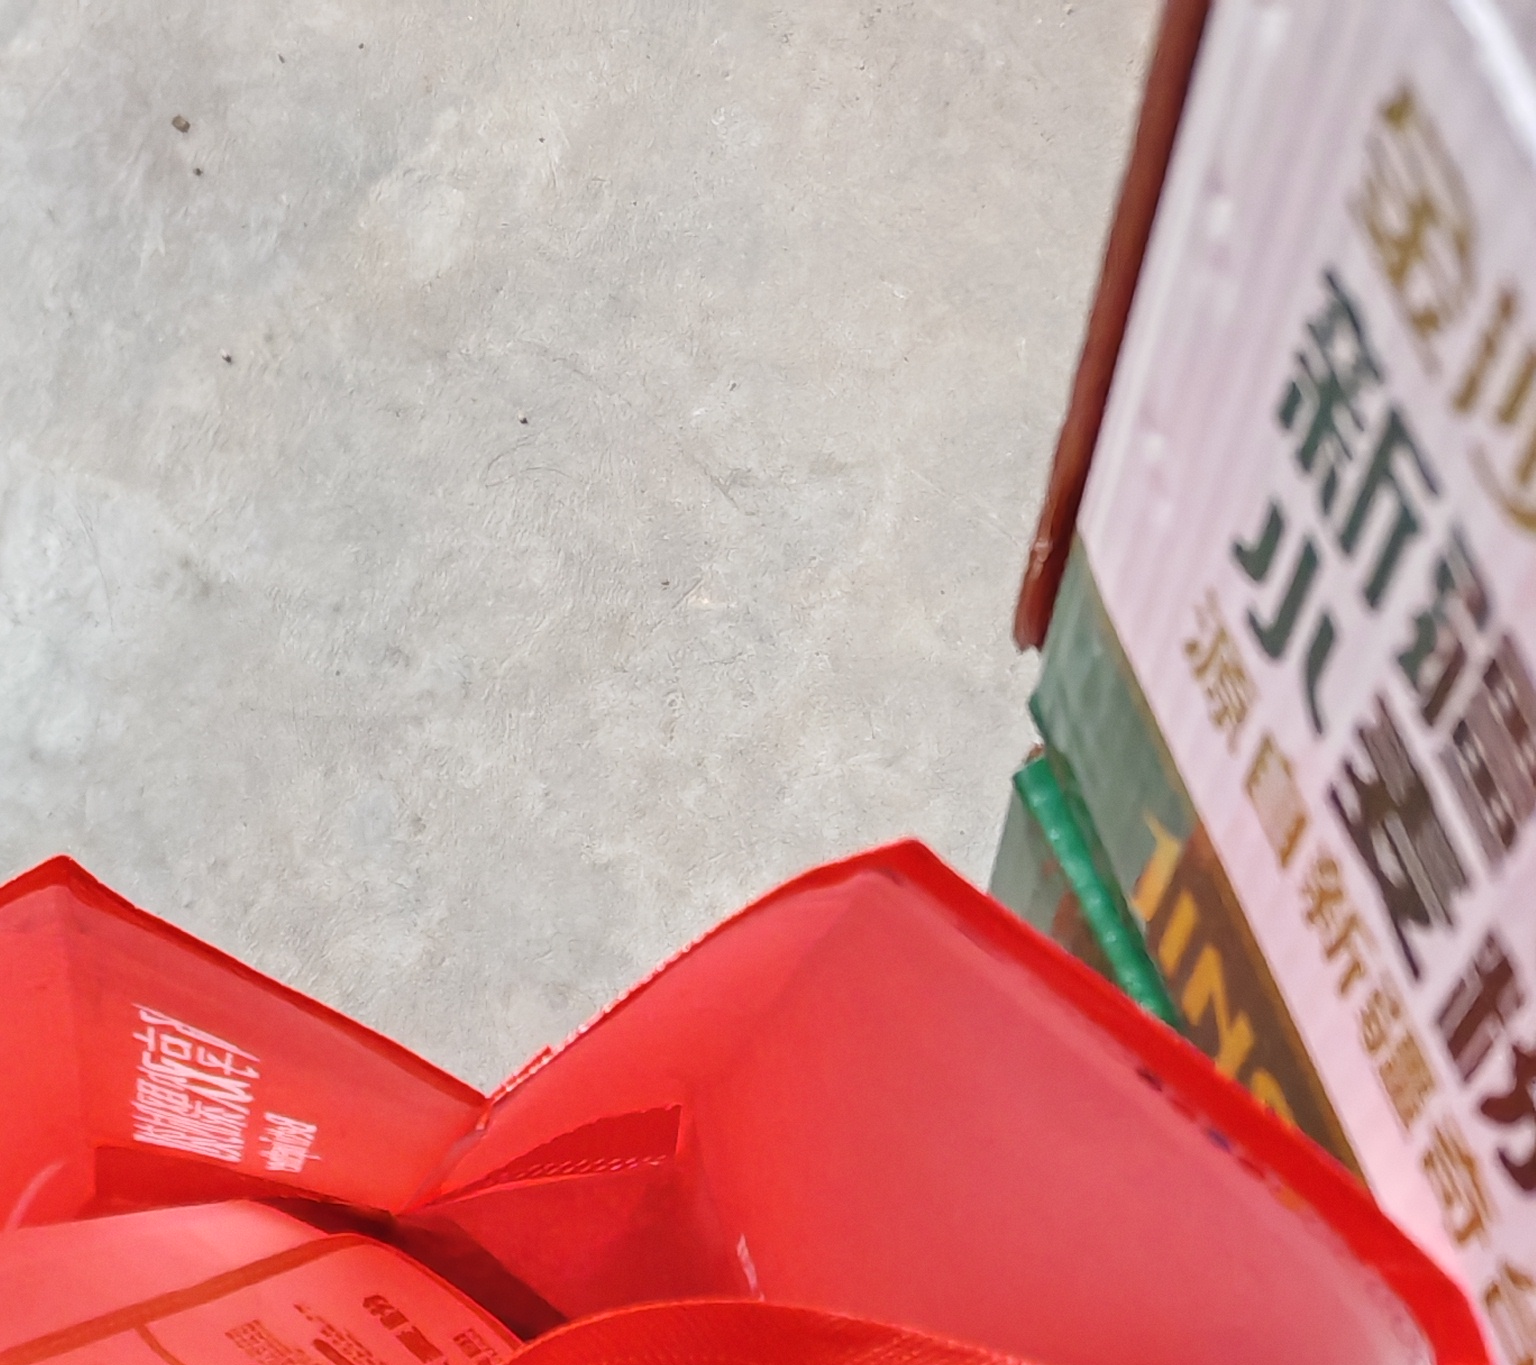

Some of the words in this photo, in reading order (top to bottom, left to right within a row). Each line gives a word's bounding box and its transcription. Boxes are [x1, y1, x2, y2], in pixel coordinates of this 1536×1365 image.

[1232, 503, 1536, 1197] 小麦粉
[1276, 266, 1536, 872] 新疆
